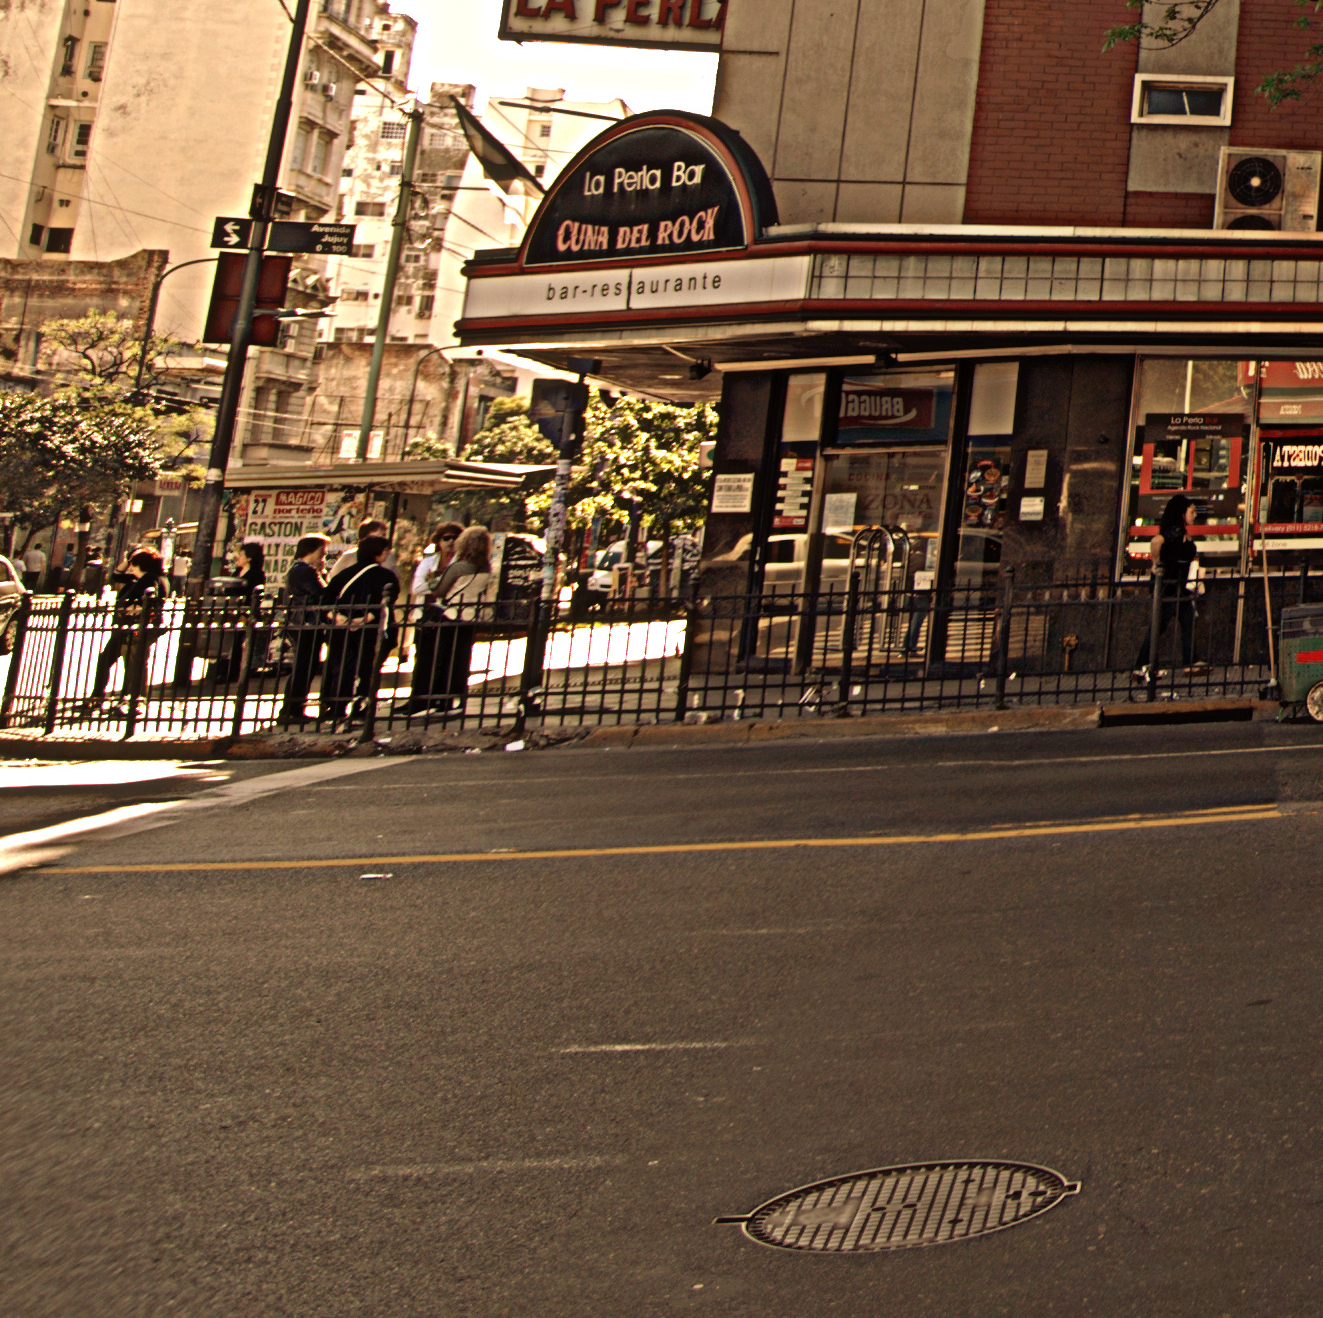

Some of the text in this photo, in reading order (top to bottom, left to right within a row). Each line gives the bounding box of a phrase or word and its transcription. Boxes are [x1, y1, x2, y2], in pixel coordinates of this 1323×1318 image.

[584, 162, 706, 196] La Perla Bar
[310, 224, 350, 234] Avenida
[556, 206, 721, 253] CUNA DEL ROCK
[321, 234, 348, 244] Jujuy
[546, 272, 722, 301] bar-resaurante
[251, 498, 267, 515] 27
[277, 492, 323, 506] MAGICO
[273, 506, 323, 516] norteño
[248, 521, 303, 538] GASTON
